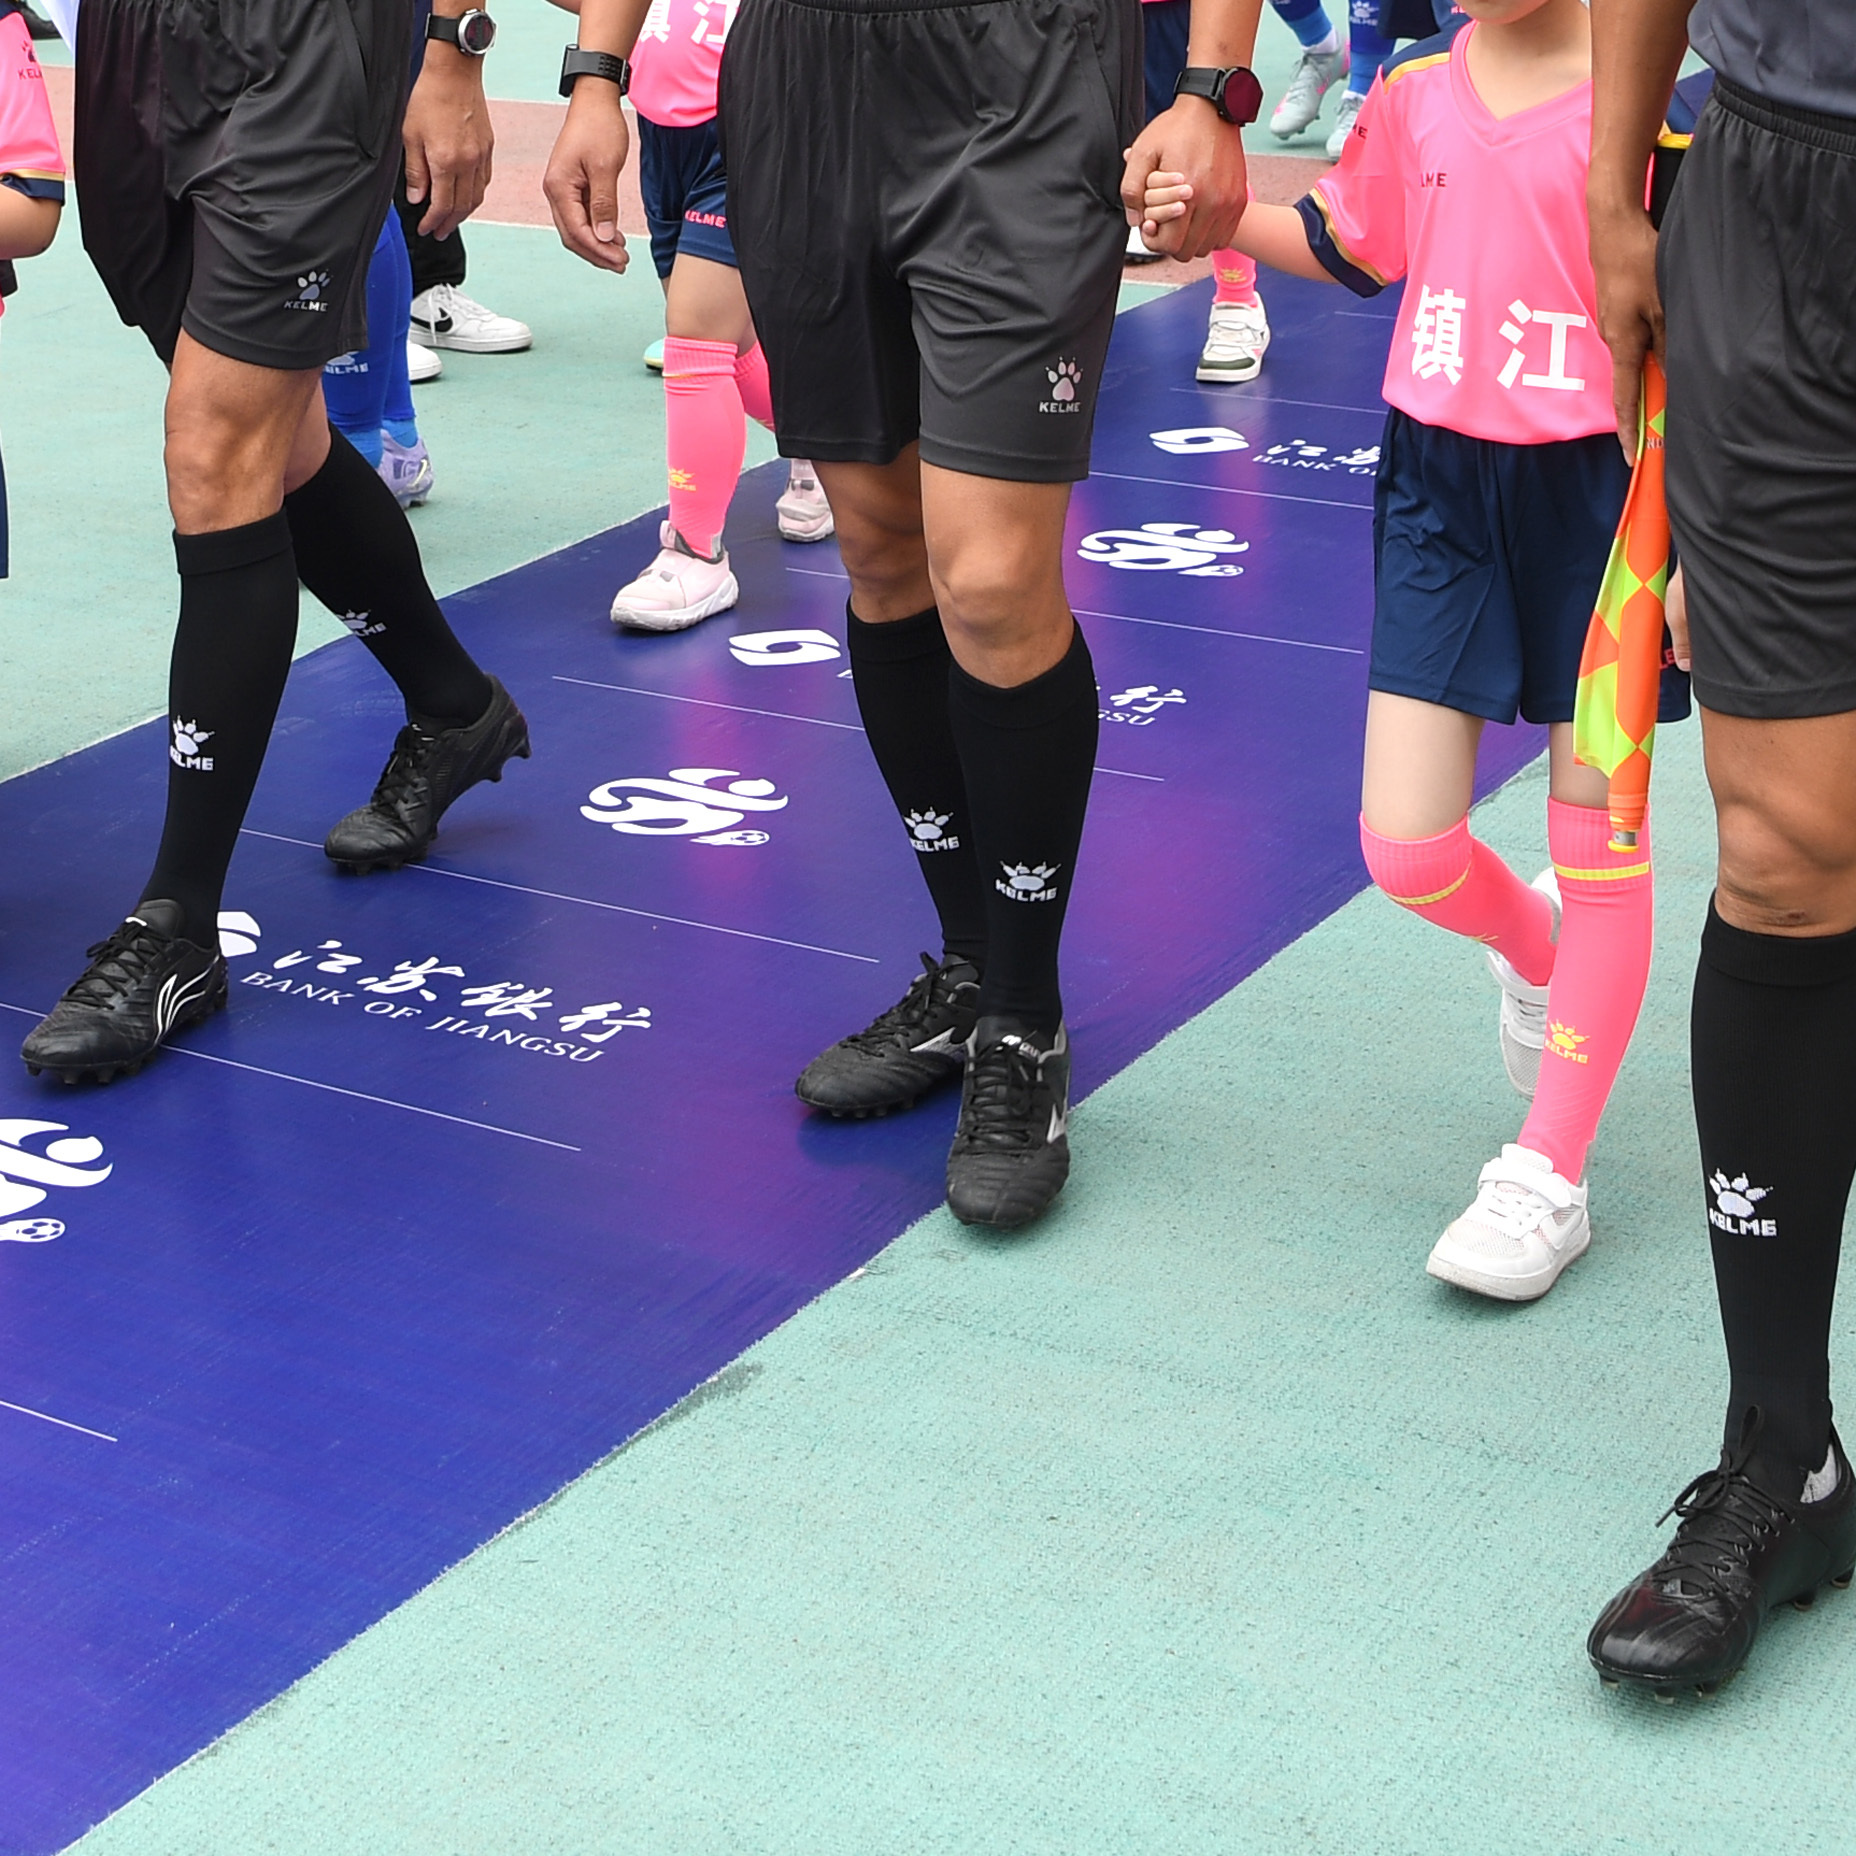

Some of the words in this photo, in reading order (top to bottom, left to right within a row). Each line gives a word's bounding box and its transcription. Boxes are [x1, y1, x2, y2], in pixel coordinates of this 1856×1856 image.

[283, 300, 328, 312] KELME
[1410, 284, 1587, 392] 镇江
[1038, 401, 1081, 414] KELME
[995, 878, 1057, 904] KELME
[272, 939, 653, 1043] 江苏银行
[239, 970, 350, 1009] BANK
[362, 999, 422, 1021] OF
[424, 1011, 611, 1064] JIANGSU
[1709, 1209, 1778, 1238] KELME
